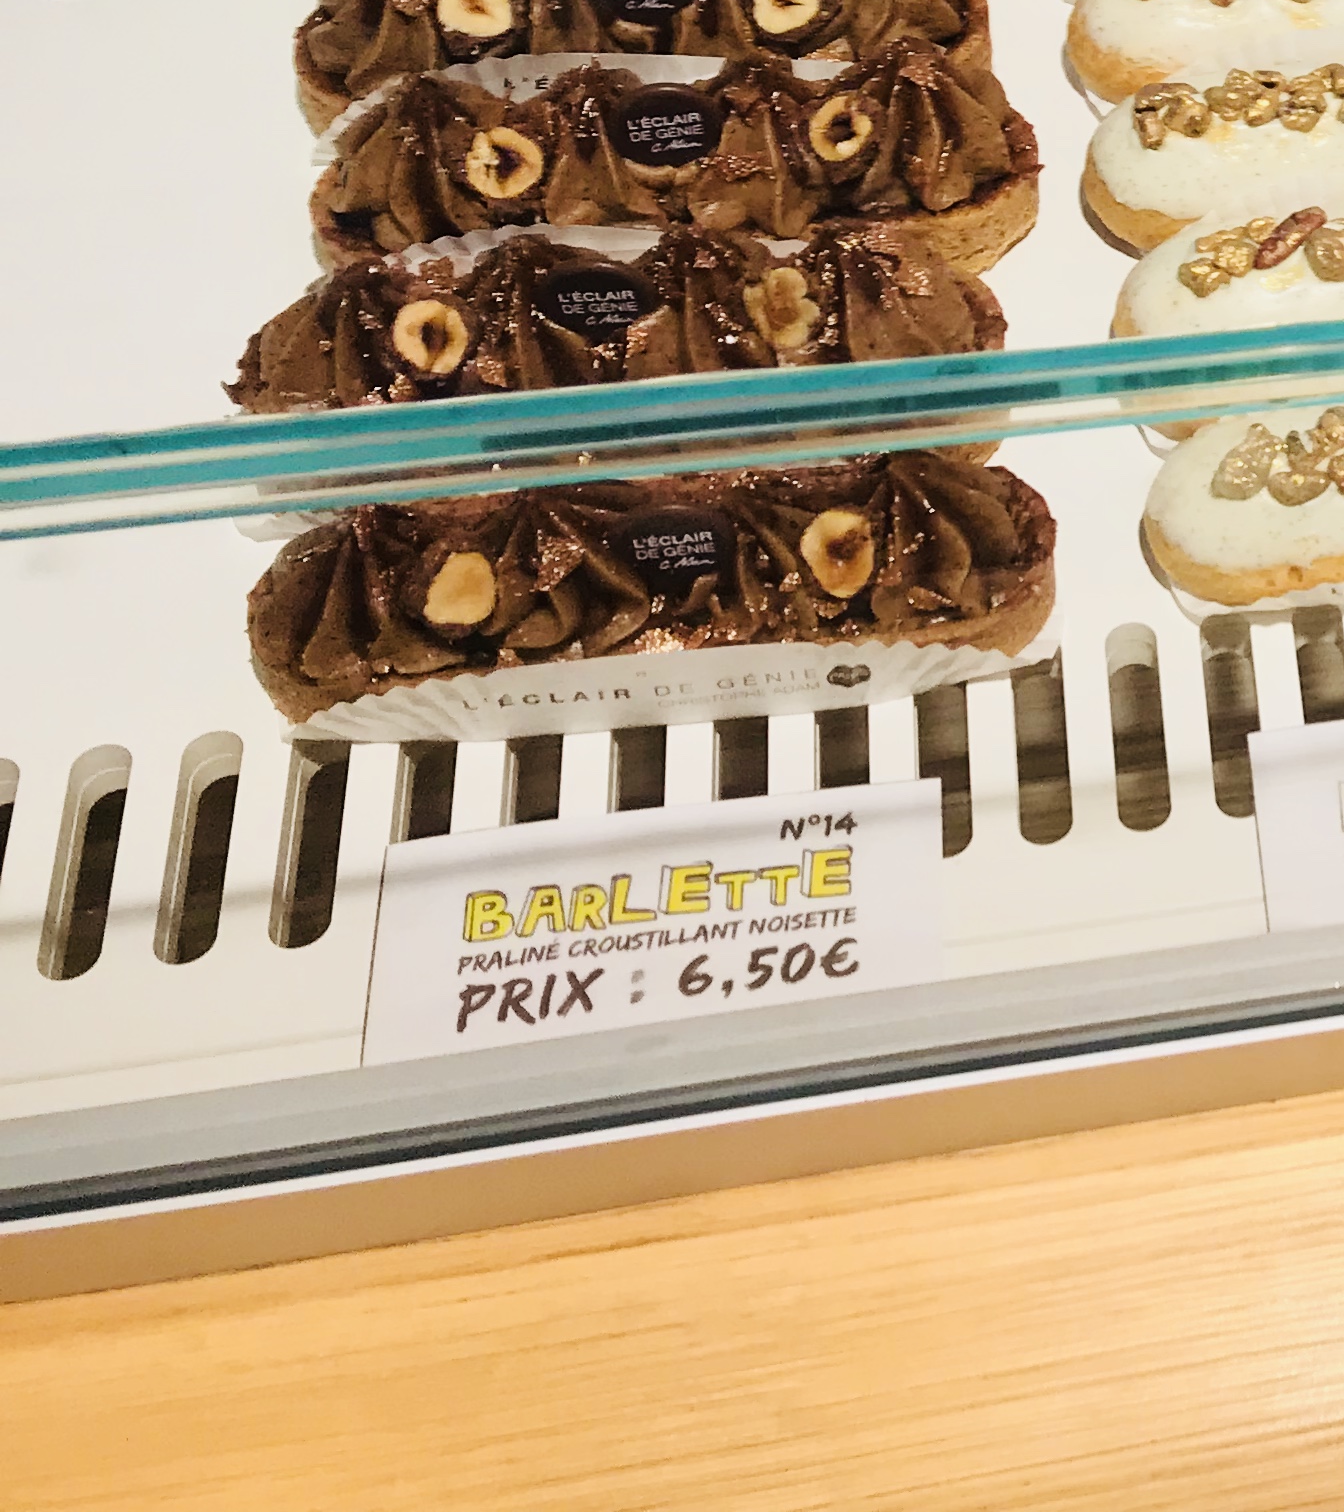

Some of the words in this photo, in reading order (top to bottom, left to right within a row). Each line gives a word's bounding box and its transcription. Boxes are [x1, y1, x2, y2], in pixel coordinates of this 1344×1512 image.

[629, 130, 652, 143] DE
[562, 303, 585, 314] DE
[632, 531, 712, 549] L'ÉCLAIR
[635, 548, 660, 560] DE
[654, 683, 694, 697] DE
[780, 811, 858, 841] N°14
[463, 844, 853, 942] BARLETTE
[458, 942, 560, 975] PRALINÉ
[568, 921, 743, 958] CROUSTILLANT
[749, 906, 857, 934] NOISETTE
[456, 968, 603, 1033] PRIX
[678, 937, 859, 999] 6,50€
